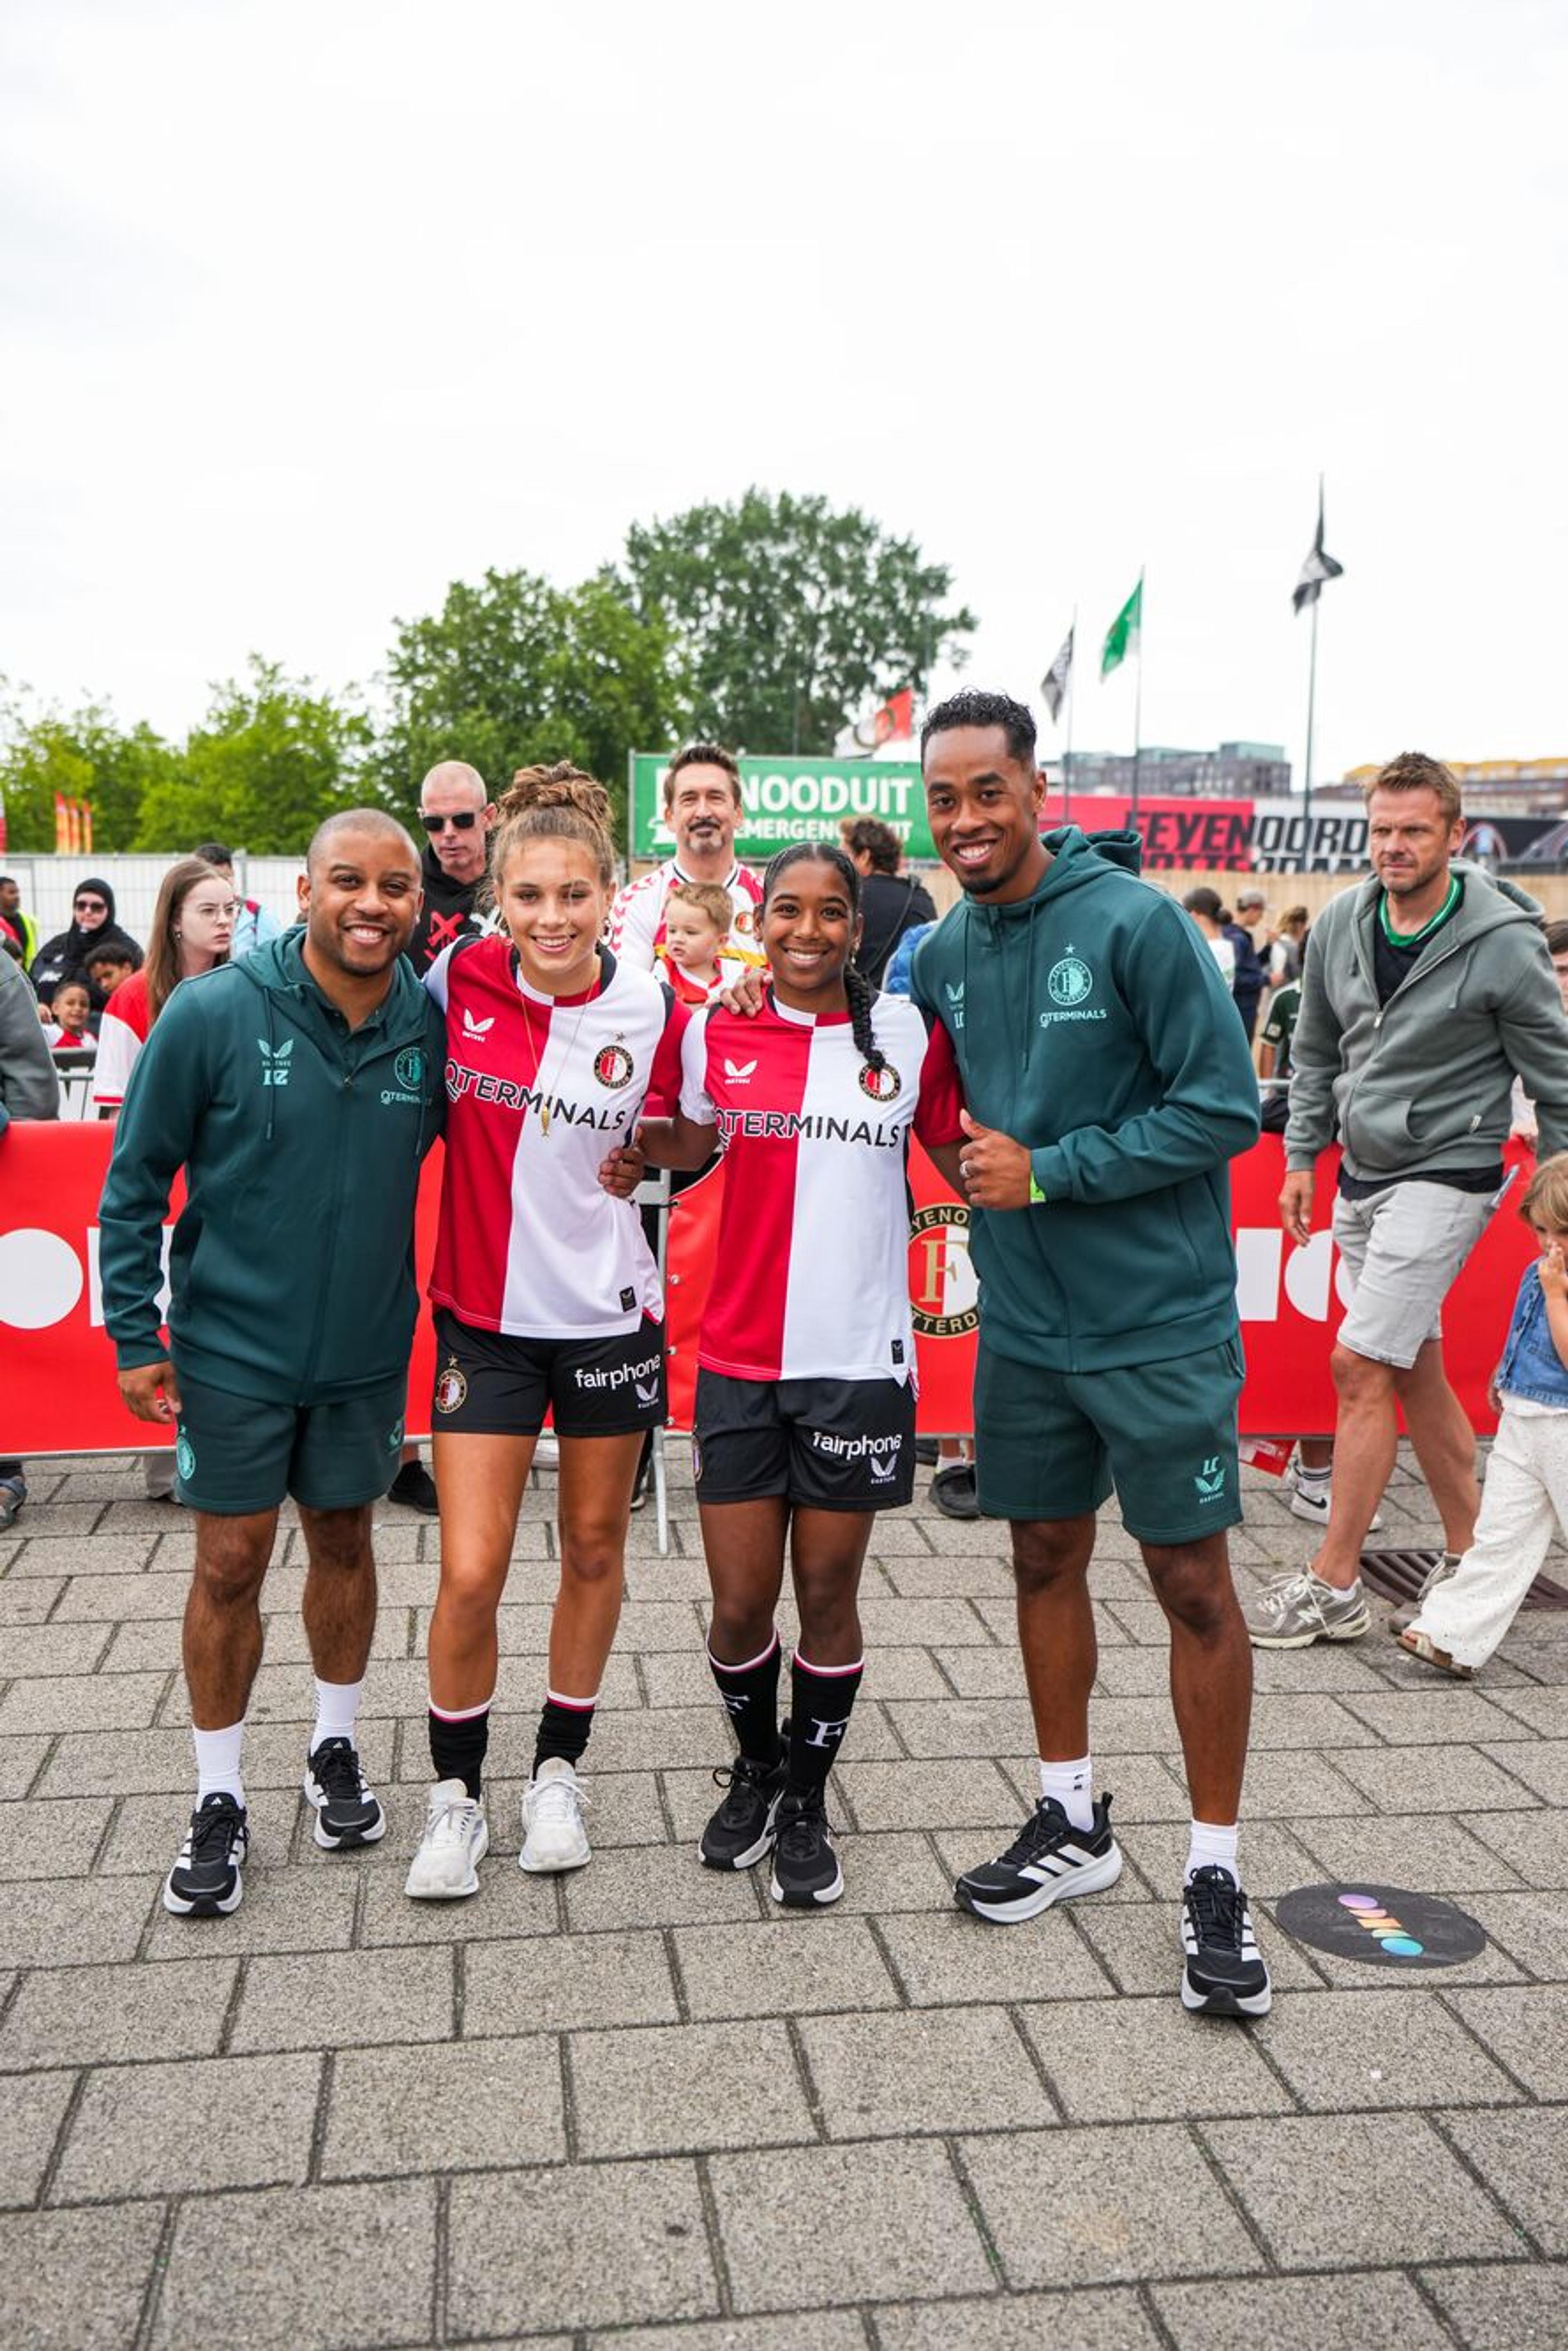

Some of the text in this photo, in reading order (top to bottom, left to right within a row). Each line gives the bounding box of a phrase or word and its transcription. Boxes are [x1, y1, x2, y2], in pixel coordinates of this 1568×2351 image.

[740, 775, 913, 814] NOODUIT
[1040, 1009, 1107, 1029] QTERMINALS
[445, 1059, 626, 1130] QTERMINALS
[909, 1208, 968, 1237] YENO
[575, 1354, 661, 1390] fairphone
[813, 1432, 902, 1461] fairphone
